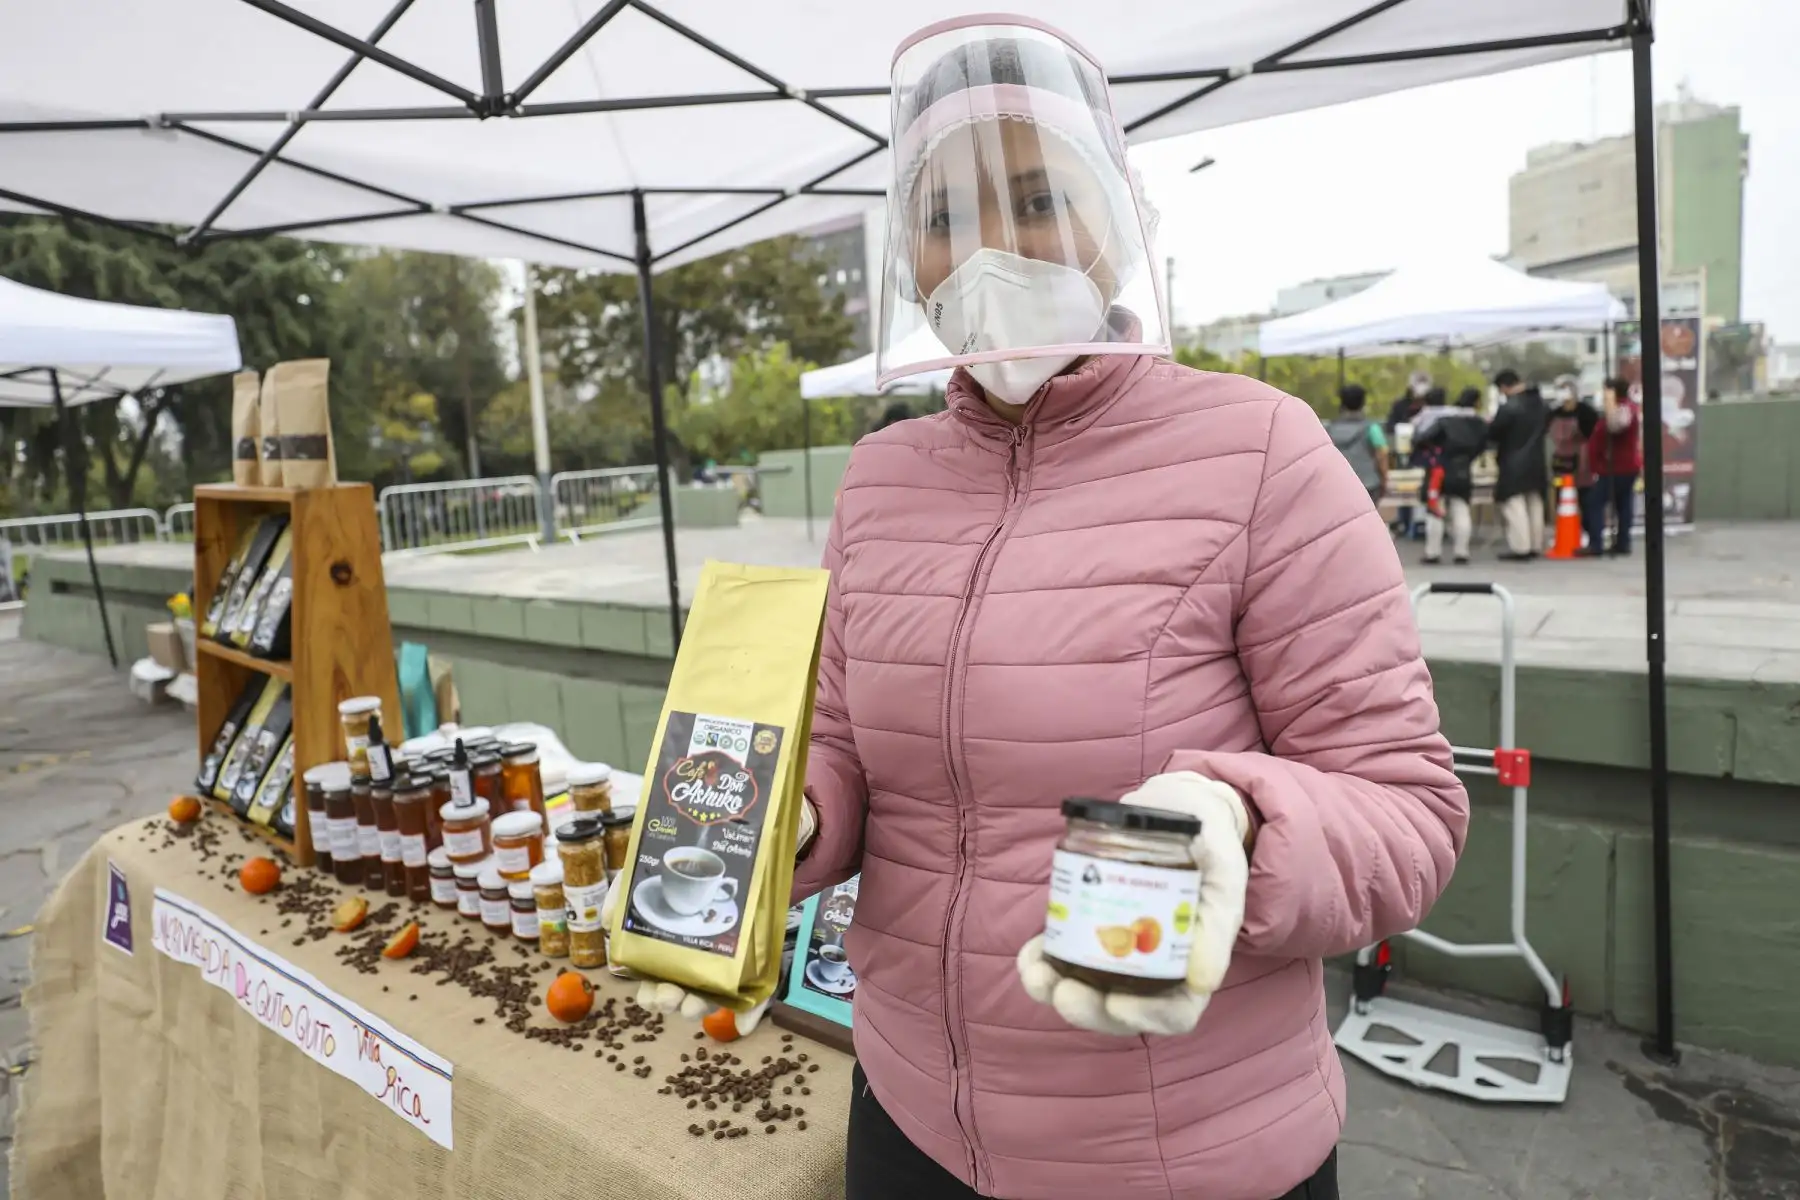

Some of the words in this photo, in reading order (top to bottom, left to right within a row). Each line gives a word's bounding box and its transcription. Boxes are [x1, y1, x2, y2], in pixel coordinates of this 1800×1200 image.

[934, 301, 944, 328] KN95
[717, 771, 750, 793] Don
[375, 1065, 431, 1124] Rica
